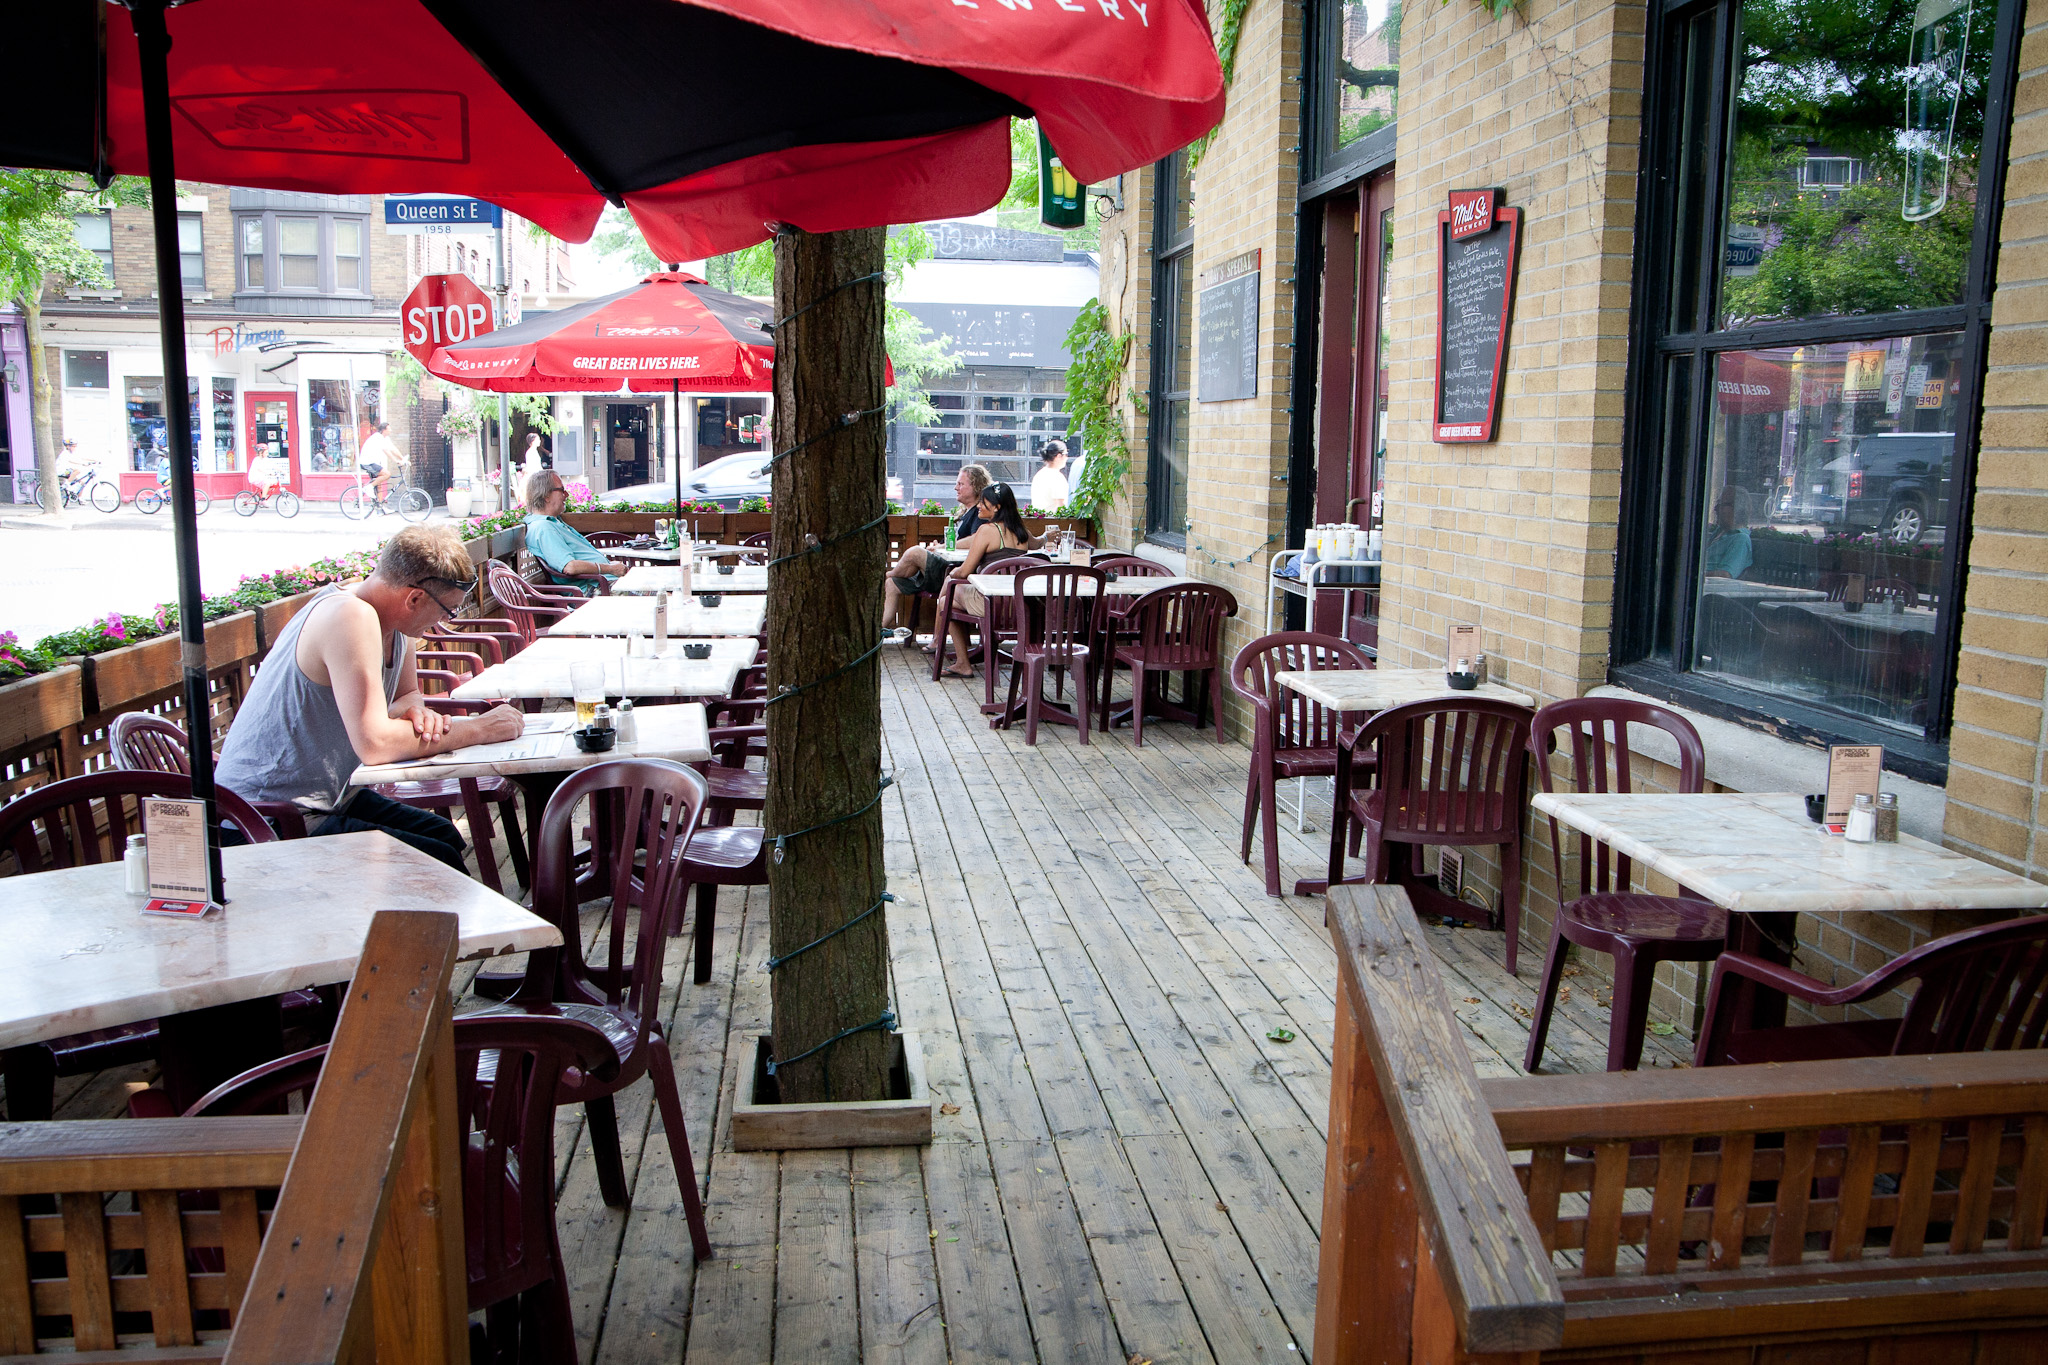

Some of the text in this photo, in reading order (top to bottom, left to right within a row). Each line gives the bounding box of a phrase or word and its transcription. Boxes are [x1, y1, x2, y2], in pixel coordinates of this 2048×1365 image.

[396, 203, 479, 220] Queen St E
[1453, 200, 1475, 227] Mill
[424, 225, 452, 234] 1958
[1454, 218, 1487, 235] BREWERY
[1227, 254, 1253, 278] SPECIAL
[408, 303, 487, 345] STOP
[470, 358, 520, 370] BREWERY
[572, 356, 701, 371] GREAT BEER LIVES HERE.
[160, 803, 188, 811] PROUDLY
[160, 809, 190, 817] PRESENTS
